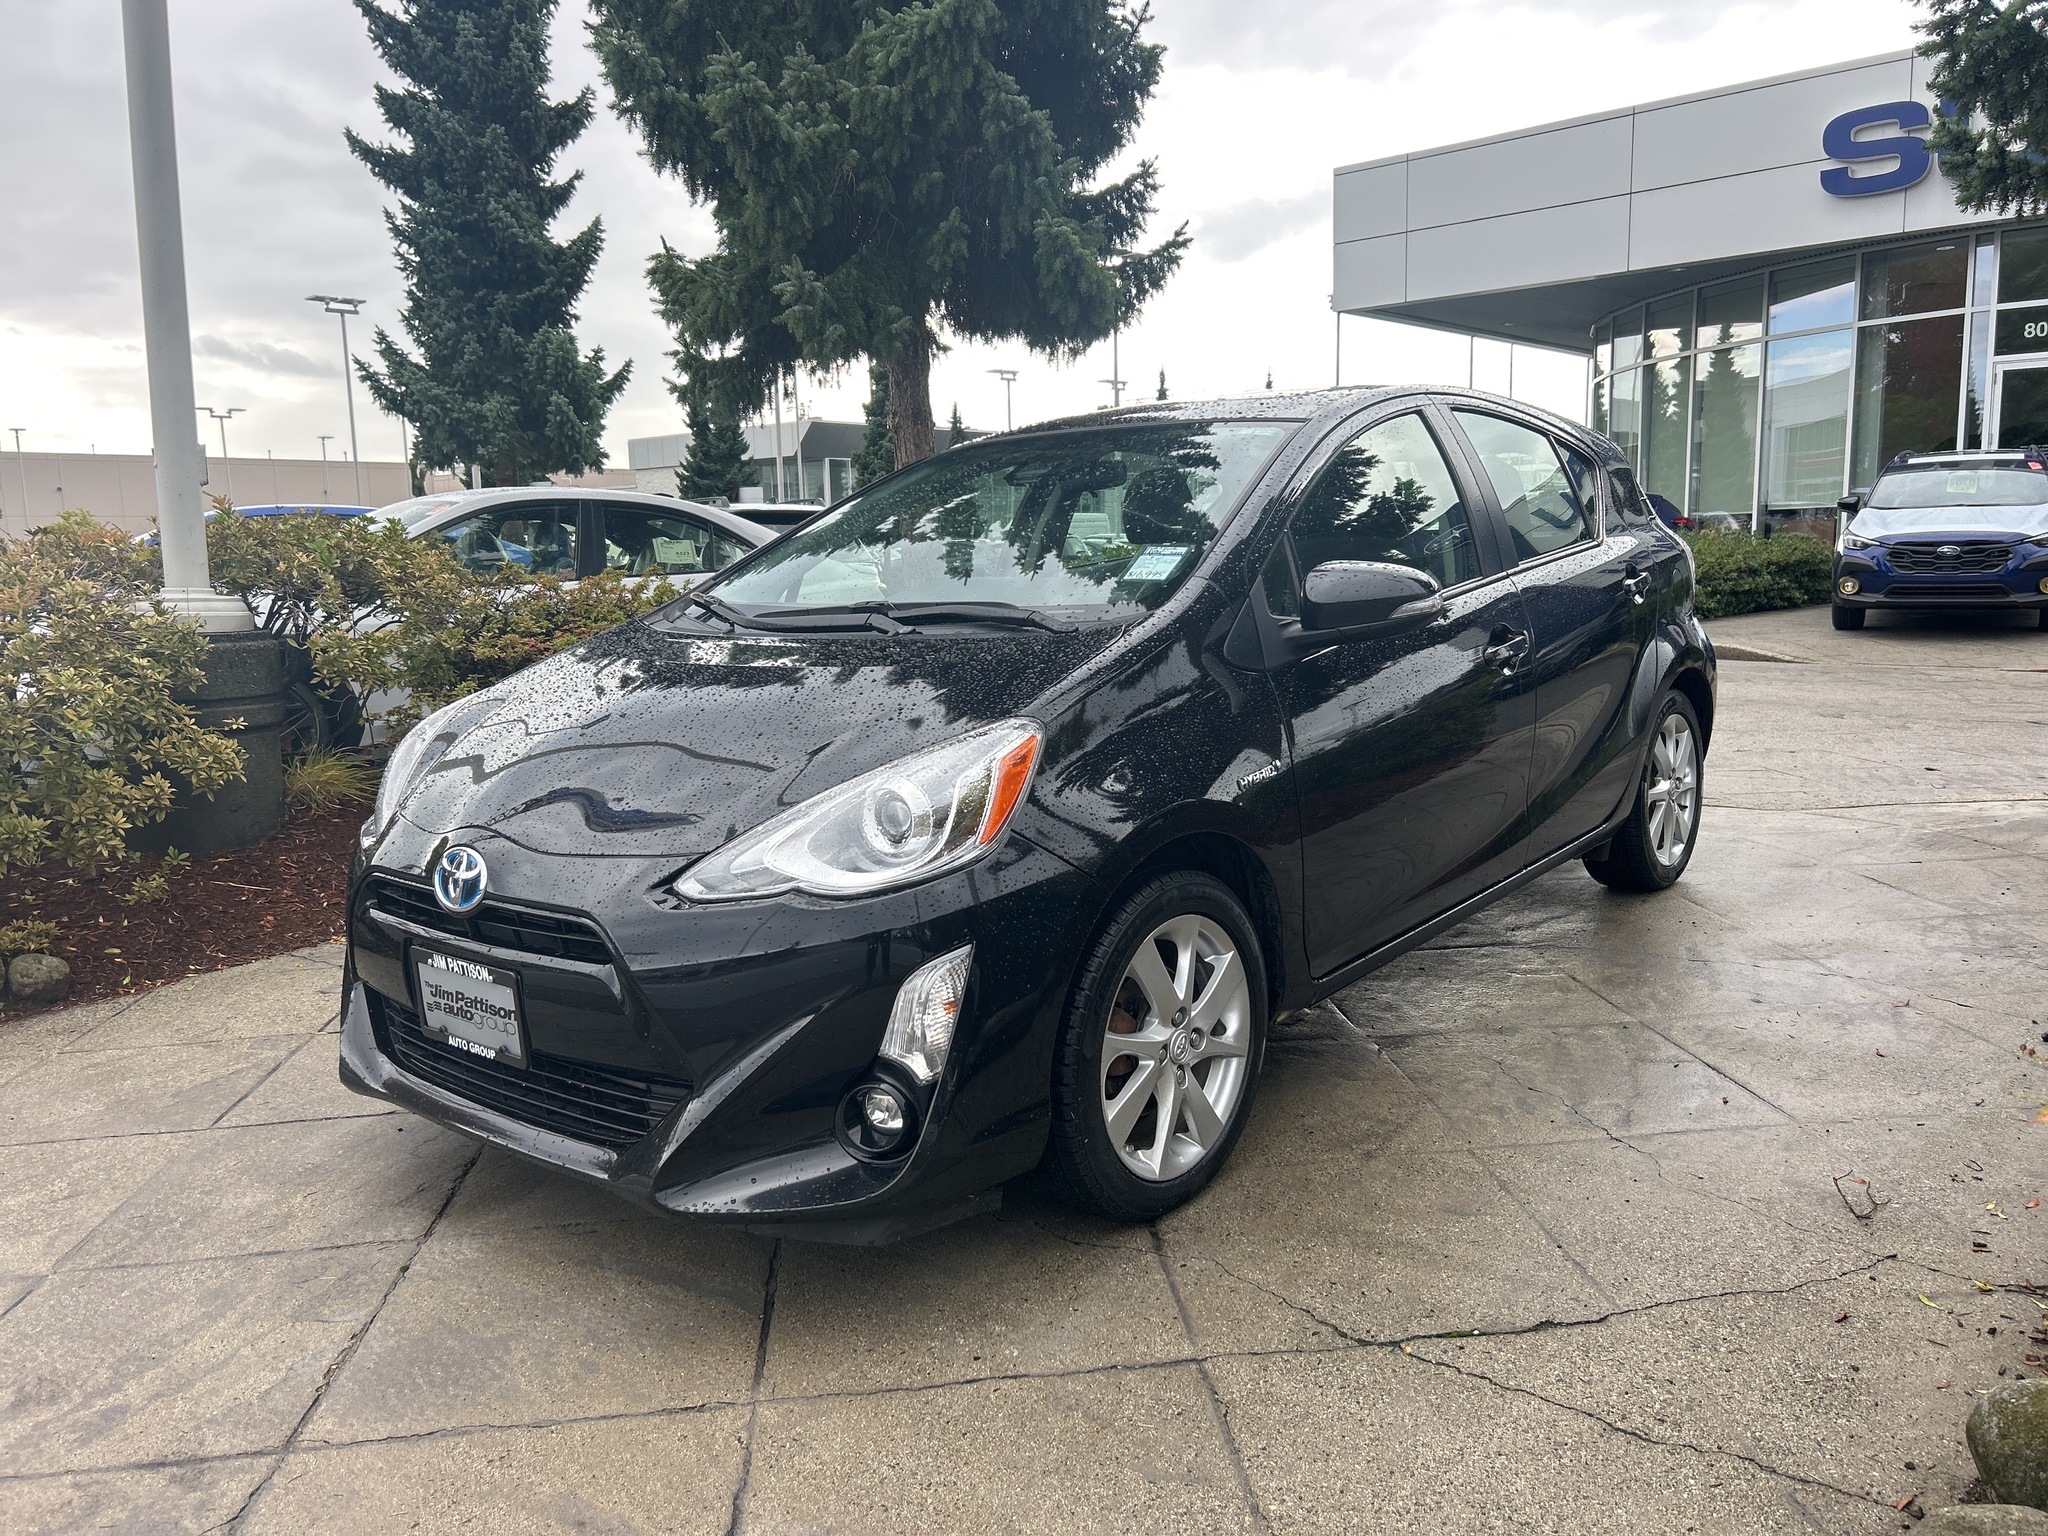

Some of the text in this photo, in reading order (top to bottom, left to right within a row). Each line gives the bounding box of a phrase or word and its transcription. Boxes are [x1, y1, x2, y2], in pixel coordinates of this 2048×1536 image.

[1127, 571, 1166, 579] $16,995
[1237, 764, 1278, 792] HYBRID
[432, 953, 490, 983] JIM PATTISON
[424, 980, 435, 989] The
[448, 1035, 496, 1060] AUTO GROUP
